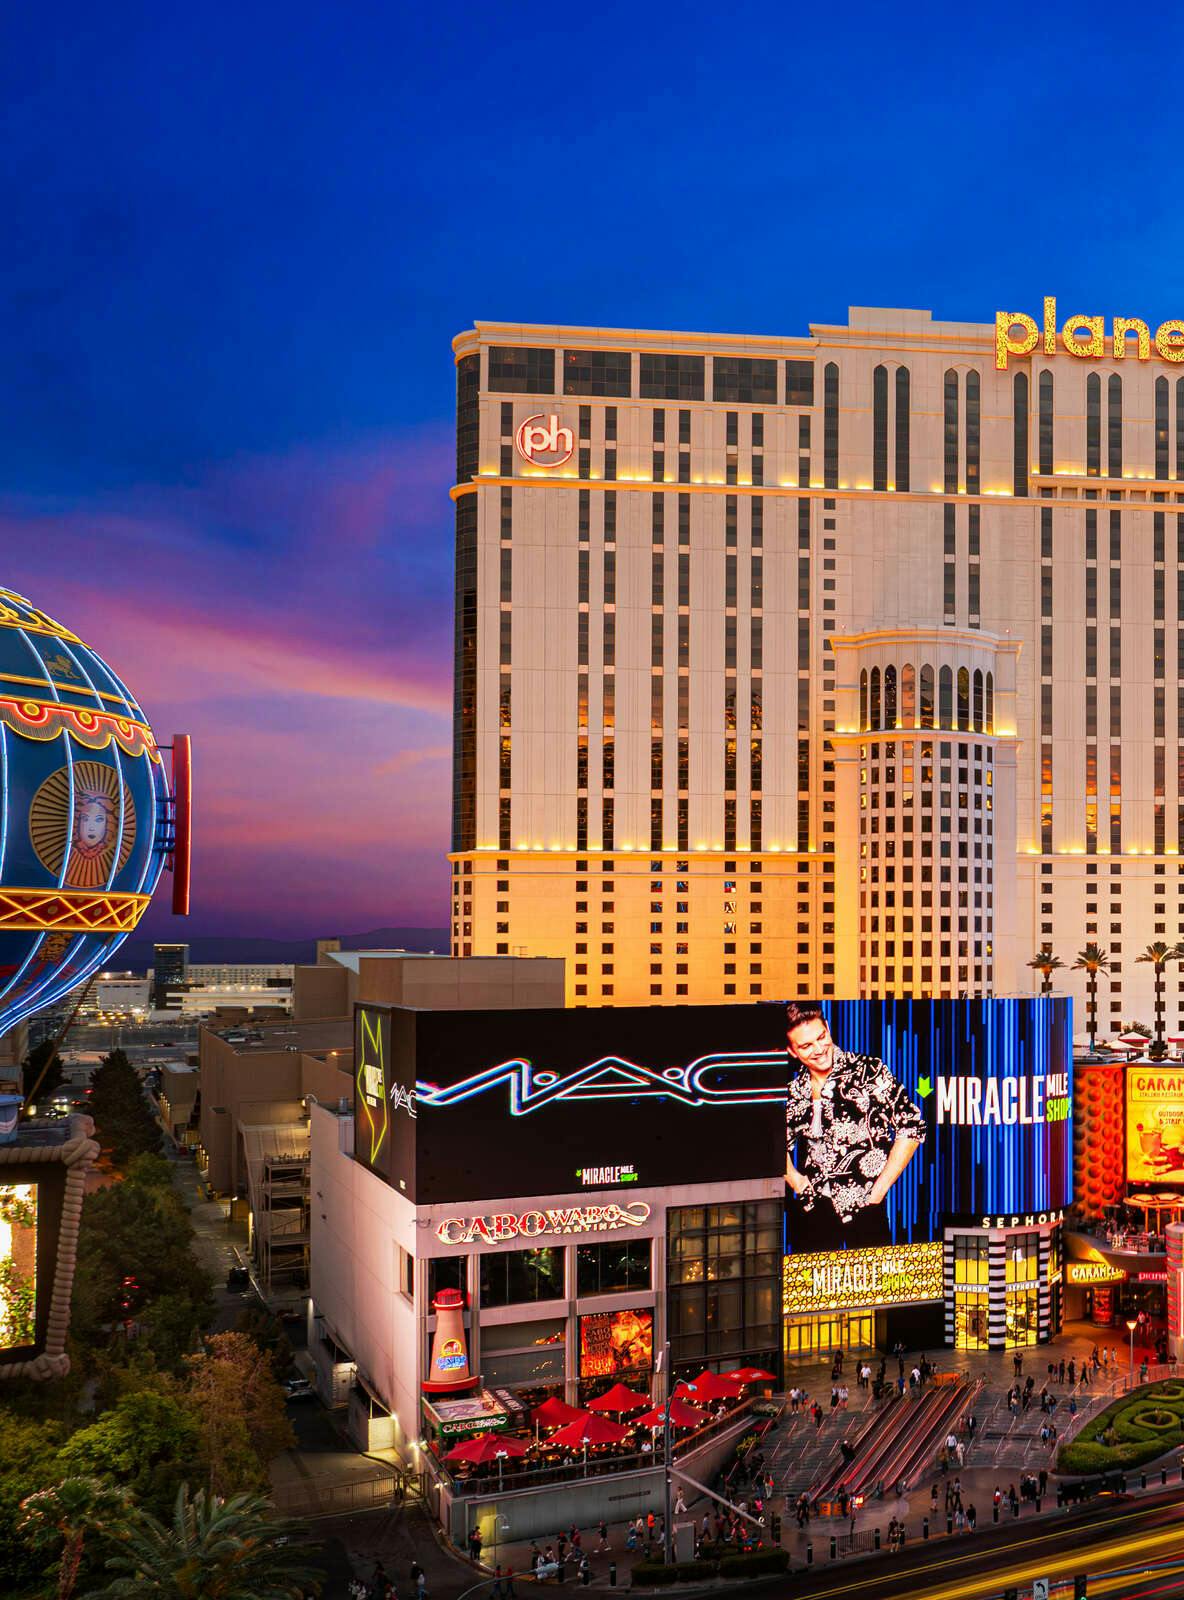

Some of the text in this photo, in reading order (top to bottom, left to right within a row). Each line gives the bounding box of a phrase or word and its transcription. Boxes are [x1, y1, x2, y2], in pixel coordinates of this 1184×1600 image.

[522, 414, 573, 458] ph
[937, 1073, 1069, 1125] MIRACLE MILE
[582, 1166, 620, 1185] MIRACLE
[436, 1203, 630, 1245] CABO WABO
[553, 1222, 618, 1235] CANTINA
[982, 1210, 1063, 1228] SEPHORA
[813, 1262, 882, 1297] MIRACLE
[1008, 1281, 1039, 1291] SEPHORA
